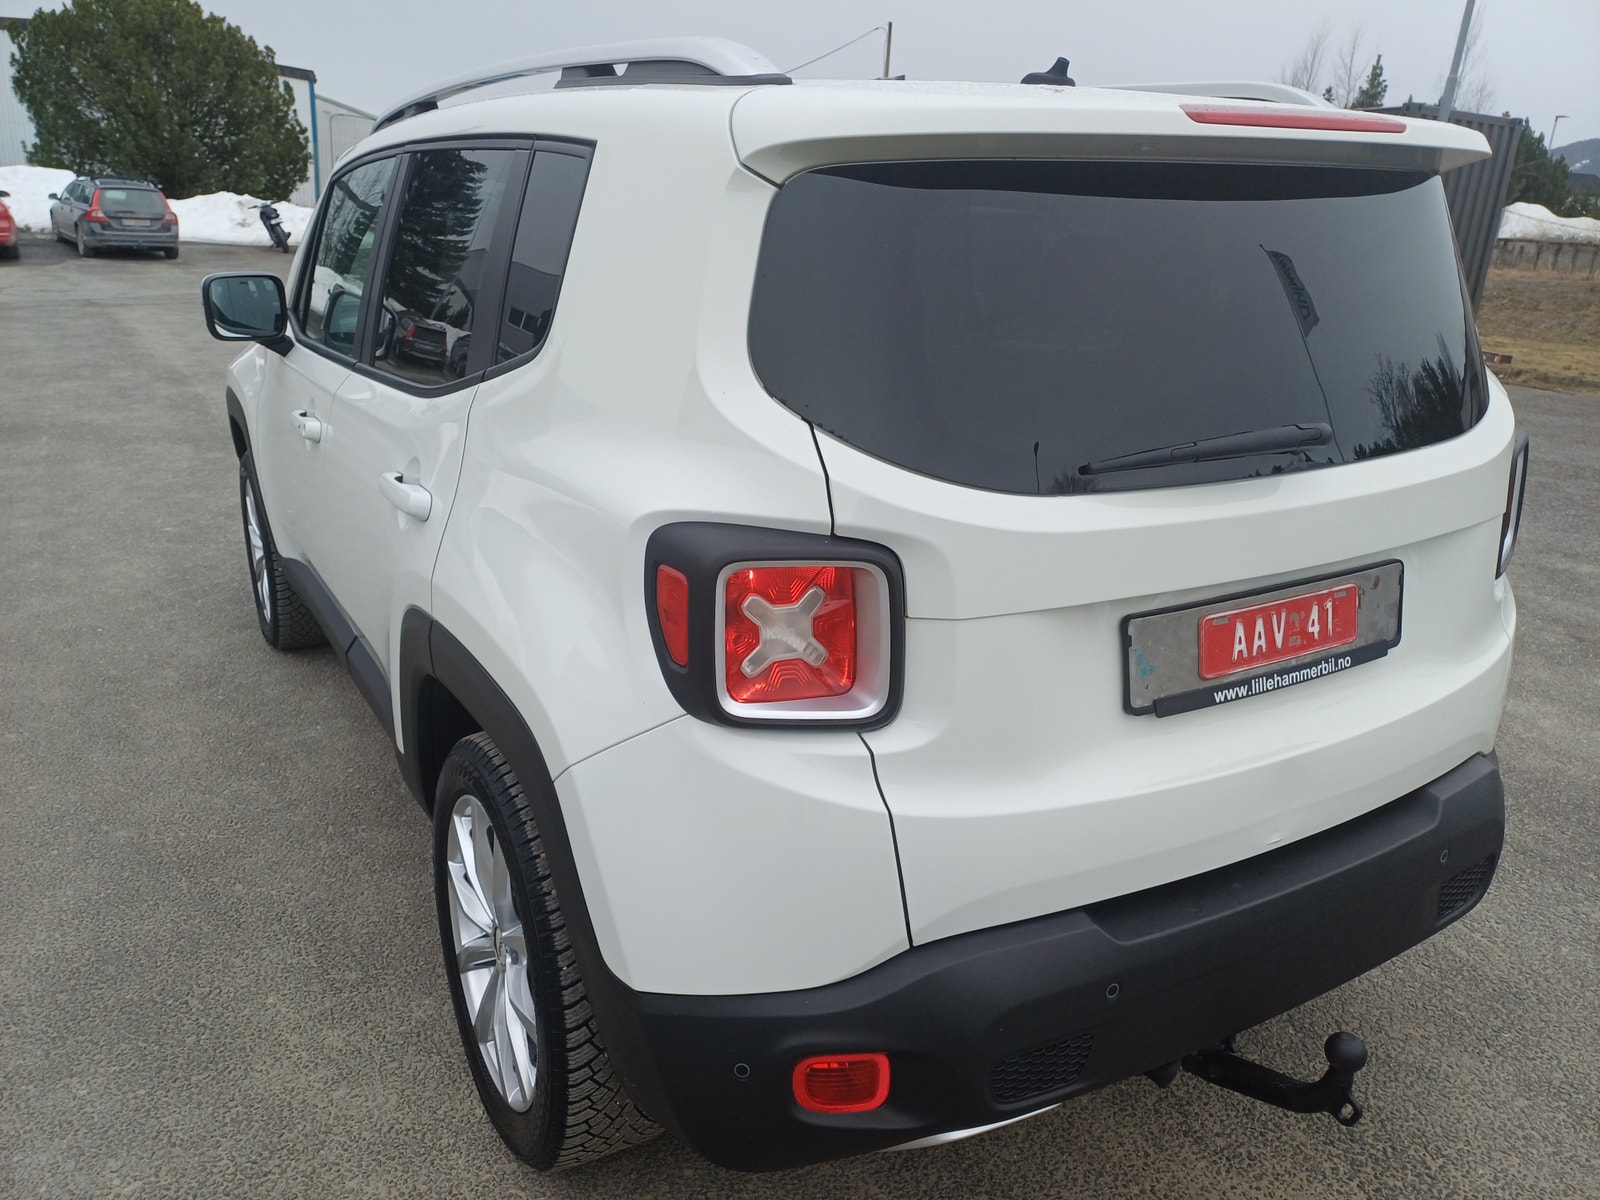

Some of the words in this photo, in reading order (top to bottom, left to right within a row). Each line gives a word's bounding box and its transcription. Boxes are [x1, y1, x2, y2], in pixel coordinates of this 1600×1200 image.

[1232, 609, 1287, 663] AAV
[1307, 597, 1333, 640] 41
[1213, 656, 1352, 704] www.lillehammerbil.no
